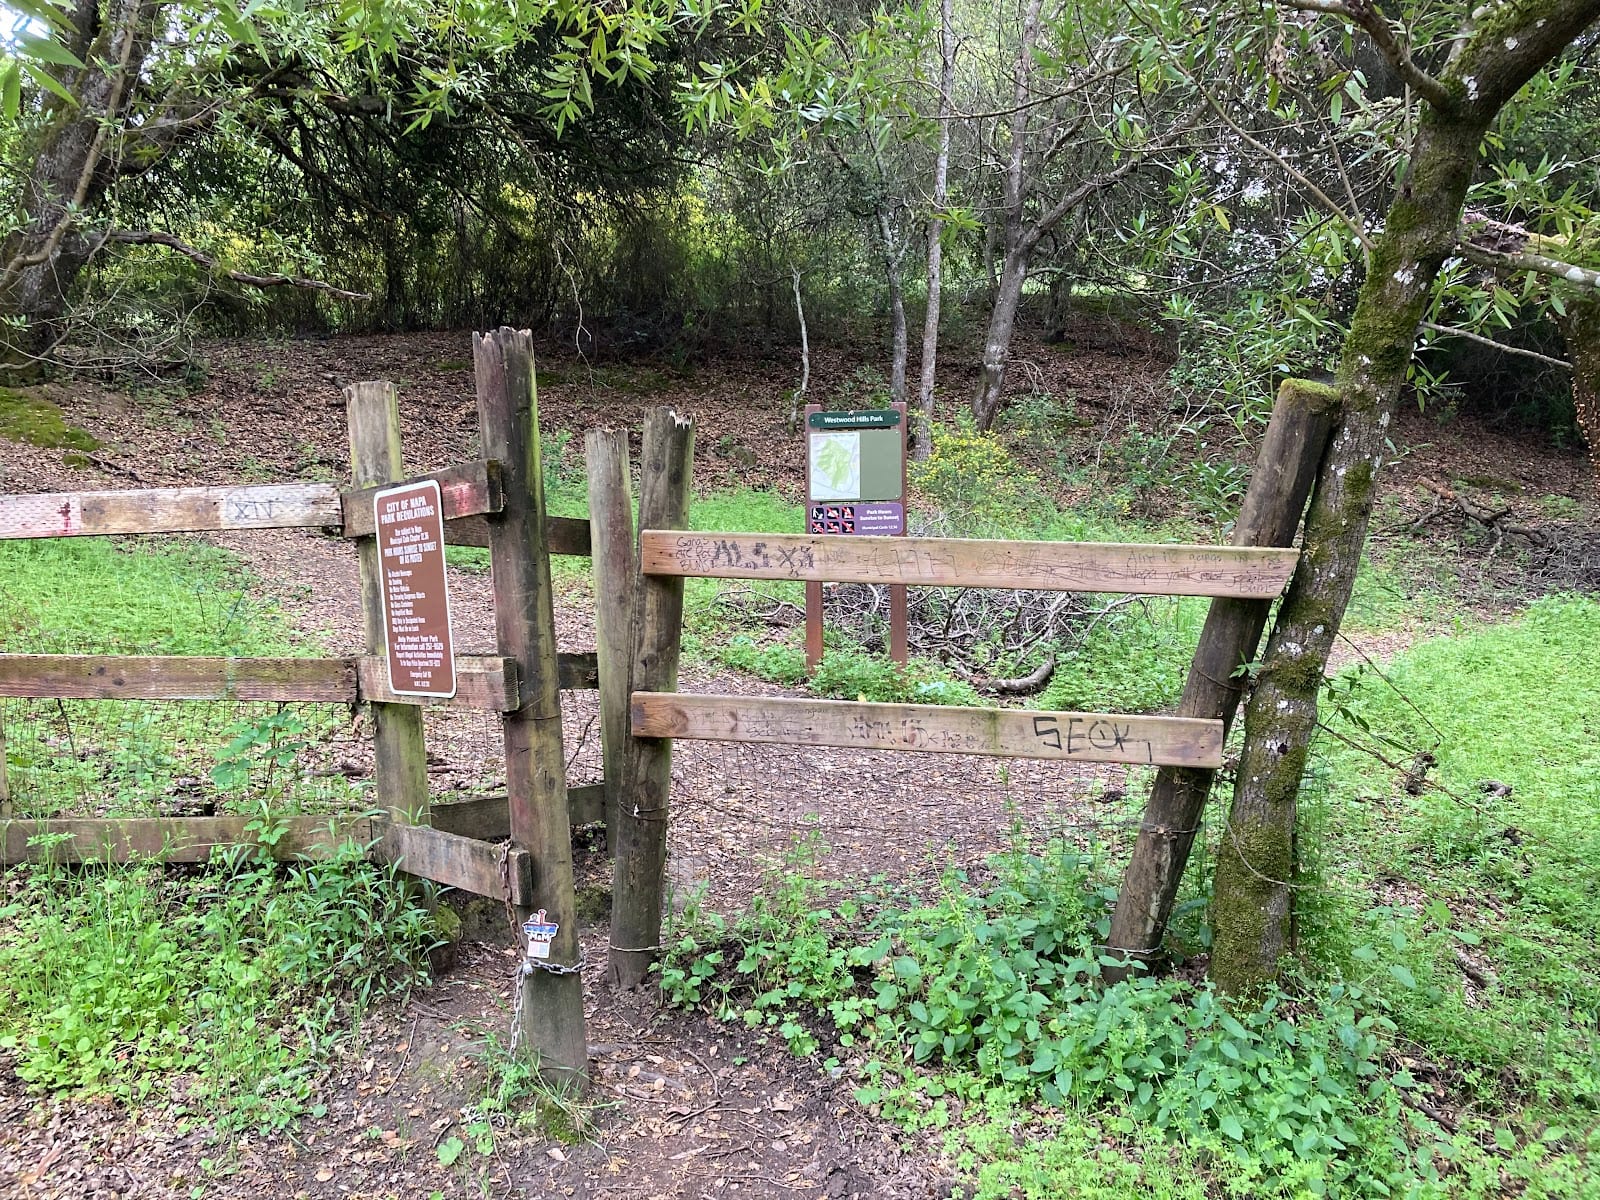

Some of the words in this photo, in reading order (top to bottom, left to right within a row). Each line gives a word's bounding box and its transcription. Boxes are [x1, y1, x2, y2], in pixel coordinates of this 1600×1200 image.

[387, 501, 400, 513] CITY
[401, 499, 409, 510] OF
[410, 496, 427, 508] NAPA
[381, 513, 396, 525] PARK
[396, 505, 434, 521] REGULATIONS
